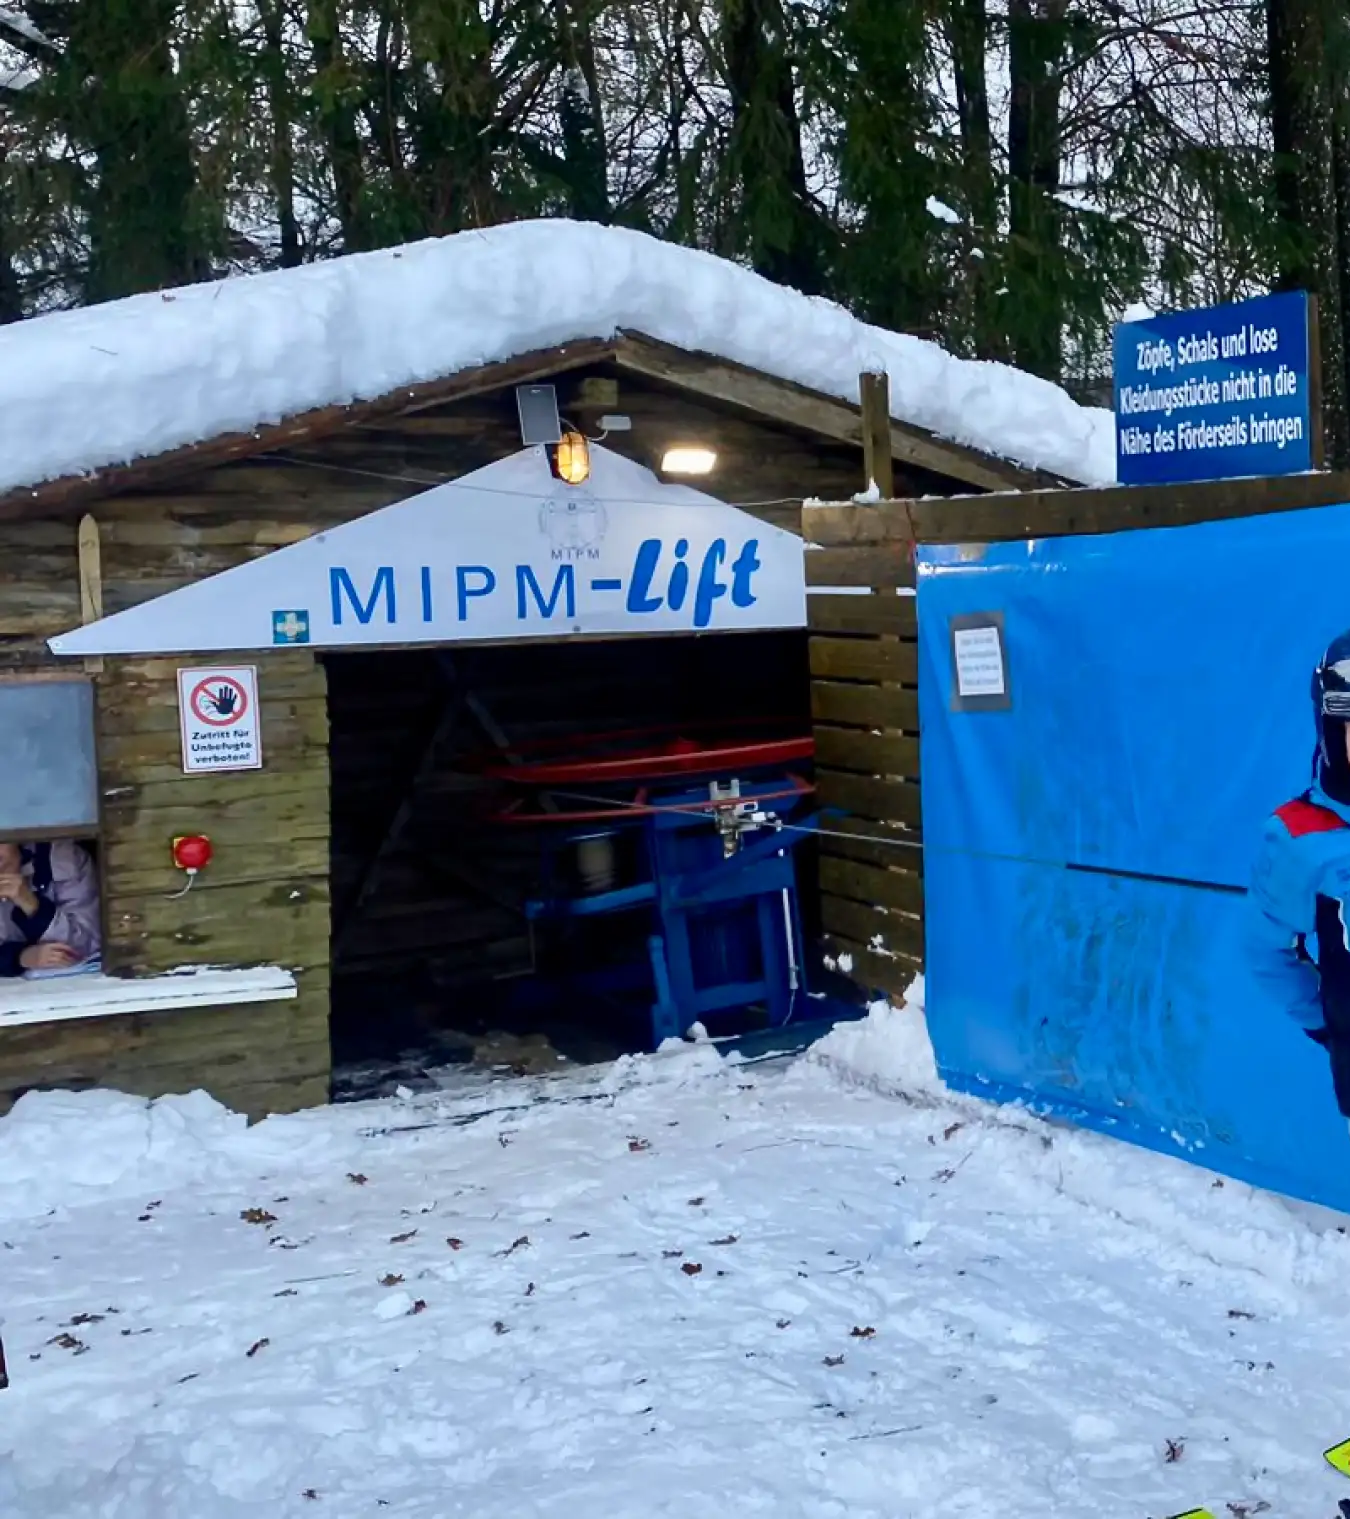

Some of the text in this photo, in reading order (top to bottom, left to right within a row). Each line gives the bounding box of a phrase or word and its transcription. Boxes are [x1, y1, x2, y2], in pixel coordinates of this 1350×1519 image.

[1136, 323, 1278, 376] Zöpfe, Schals und lose
[1119, 364, 1297, 417] Kleidungsstücke nicht in die
[1120, 411, 1302, 456] Nähe des Förderseils bringen
[551, 549, 600, 560] MIPM
[329, 538, 761, 627] MIPM-Lift
[190, 742, 252, 752] Unbefugte
[192, 730, 249, 740] Zutritt für
[195, 753, 250, 763] verboten!
